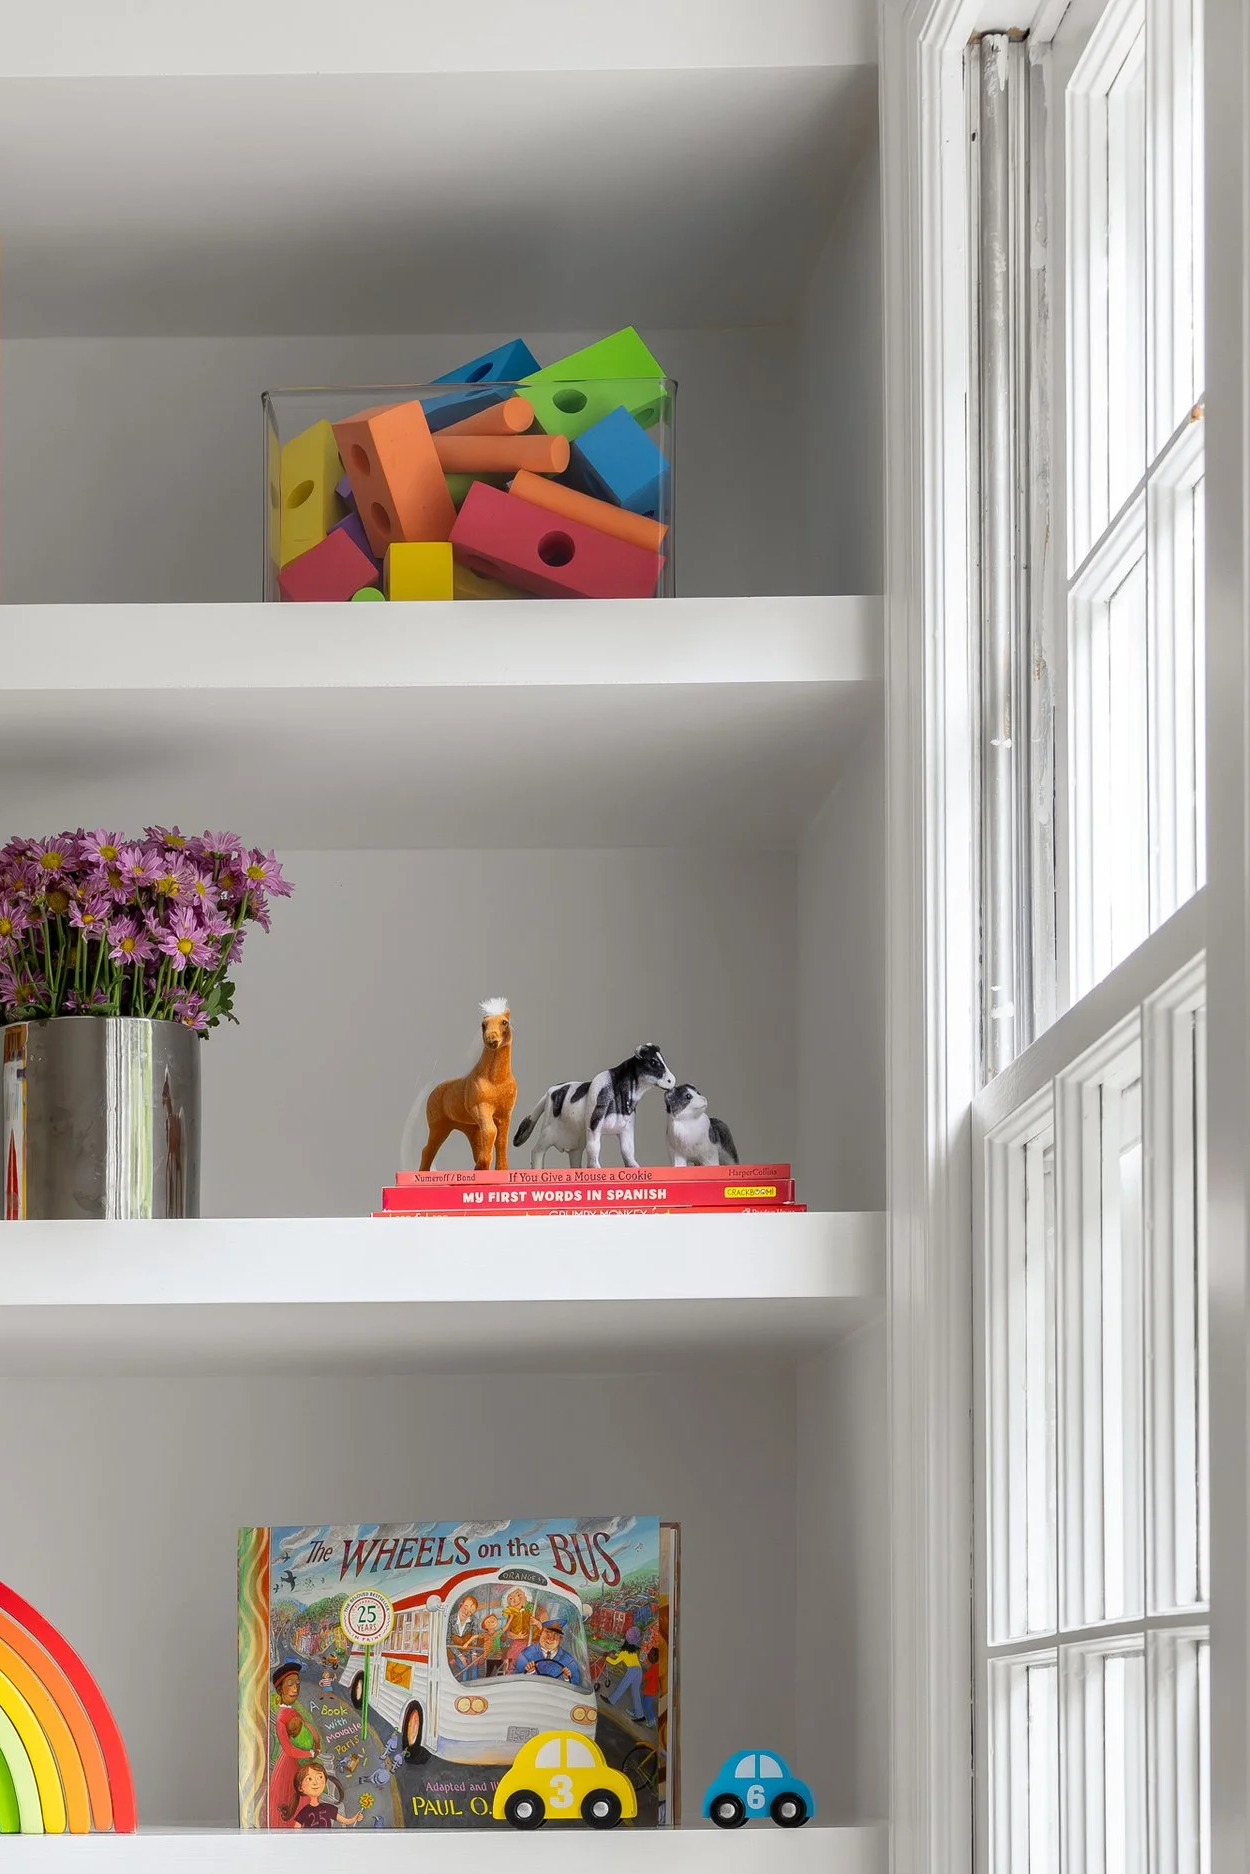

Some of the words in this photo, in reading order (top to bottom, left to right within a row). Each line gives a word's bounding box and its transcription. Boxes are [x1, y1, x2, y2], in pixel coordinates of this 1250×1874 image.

[414, 1174, 450, 1183] Numeroff
[456, 1173, 476, 1182] Bond
[509, 1172, 519, 1183] If
[518, 1172, 539, 1182] You
[540, 1172, 563, 1182] Give
[565, 1174, 572, 1182] a
[574, 1171, 607, 1181] Mouse
[609, 1173, 616, 1181] a
[618, 1170, 653, 1181] Cookie
[728, 1168, 778, 1178] HarperCollins
[462, 1192, 484, 1204] MY
[488, 1191, 527, 1203] FIRST
[531, 1190, 582, 1202] WORDS
[587, 1189, 603, 1201] IN
[606, 1188, 667, 1201] SPANISH
[306, 1540, 333, 1563] The
[339, 1536, 471, 1582] WHEELS
[477, 1543, 501, 1558] on
[508, 1537, 540, 1557] the
[545, 1532, 621, 1587] BUS
[357, 1605, 376, 1623] 25
[356, 1623, 377, 1632] YEARS
[310, 1700, 320, 1712] A
[320, 1704, 348, 1717] Book
[334, 1734, 360, 1755] Parts
[425, 1781, 465, 1794] Adapted
[469, 1782, 487, 1792] and
[549, 1774, 574, 1809] 3
[747, 1784, 765, 1810] 6
[412, 1796, 463, 1816] PAUL
[470, 1796, 493, 1816] O.
